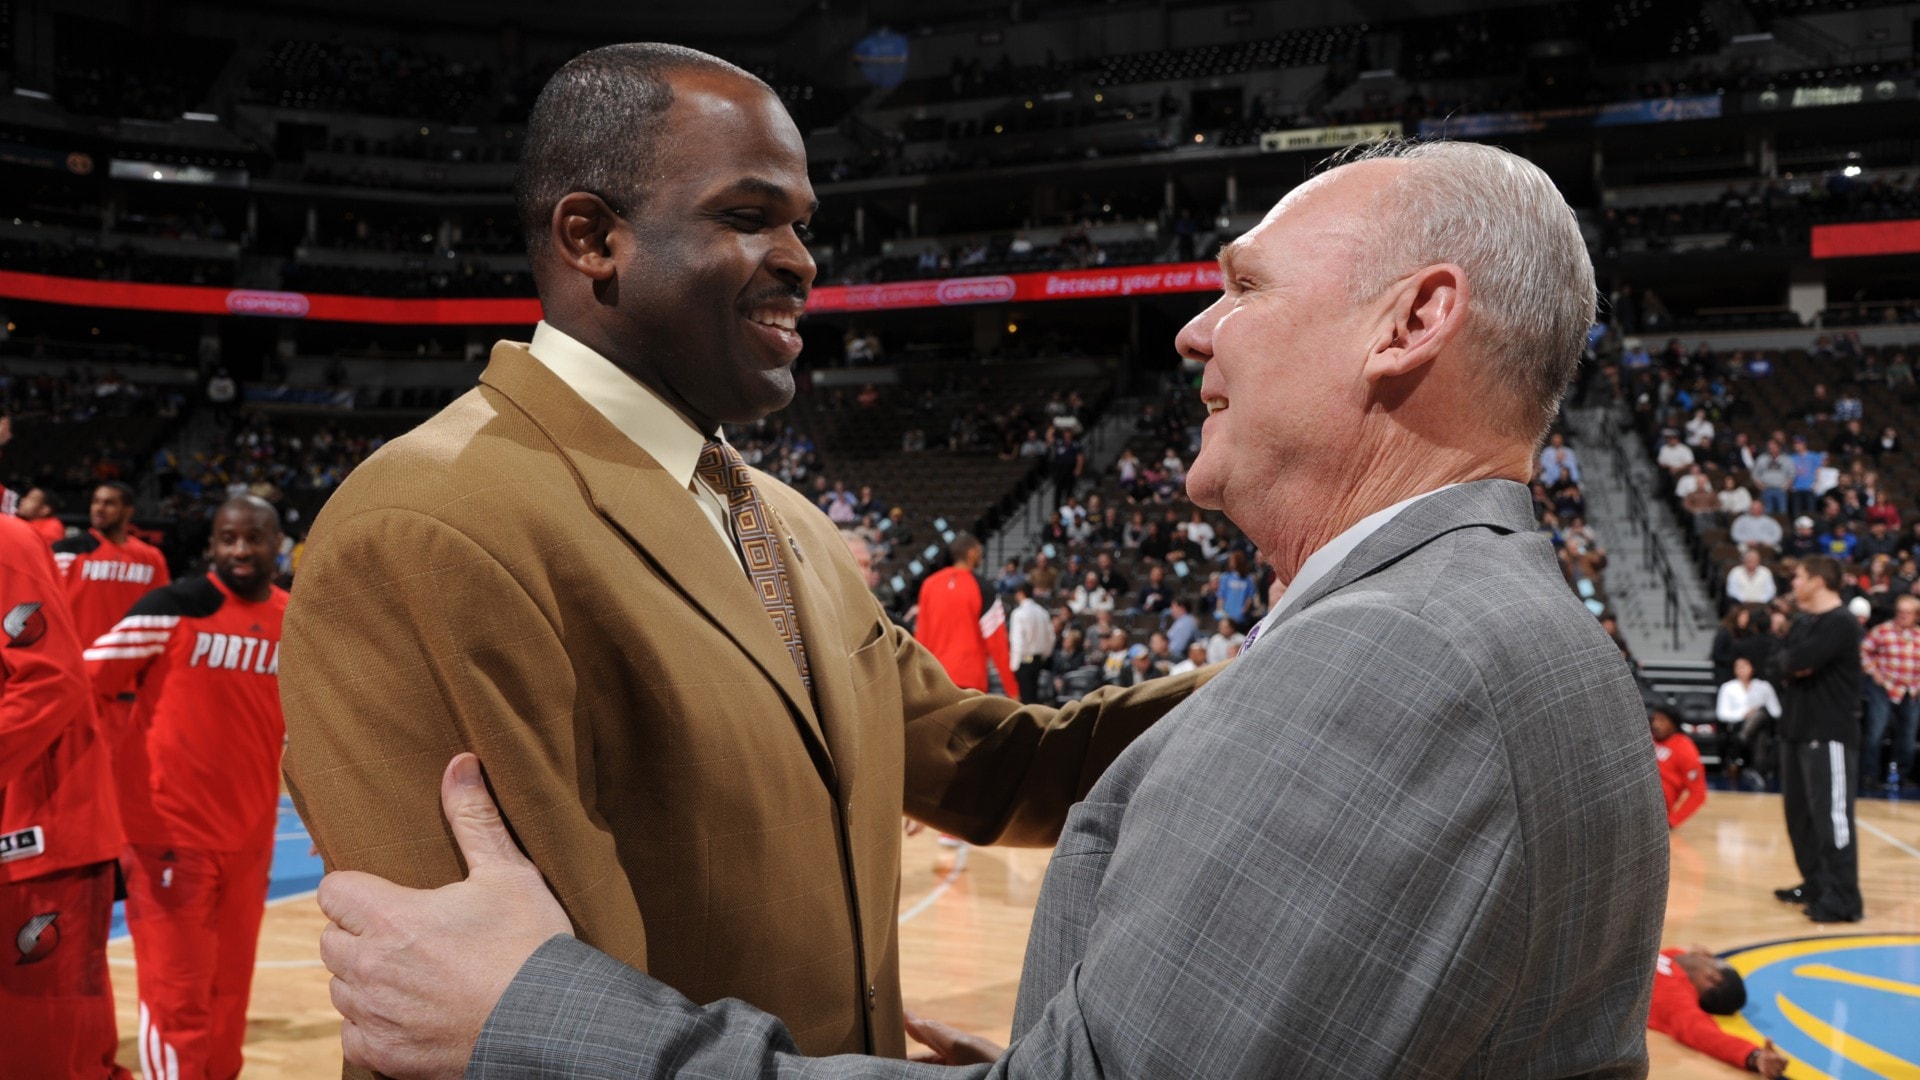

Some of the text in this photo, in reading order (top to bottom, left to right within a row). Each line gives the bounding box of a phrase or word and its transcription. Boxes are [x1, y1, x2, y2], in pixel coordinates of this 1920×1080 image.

[1046, 276, 1119, 294] Because
[1121, 274, 1161, 295] your
[1164, 271, 1193, 287] car
[82, 560, 154, 585] PORTLAND
